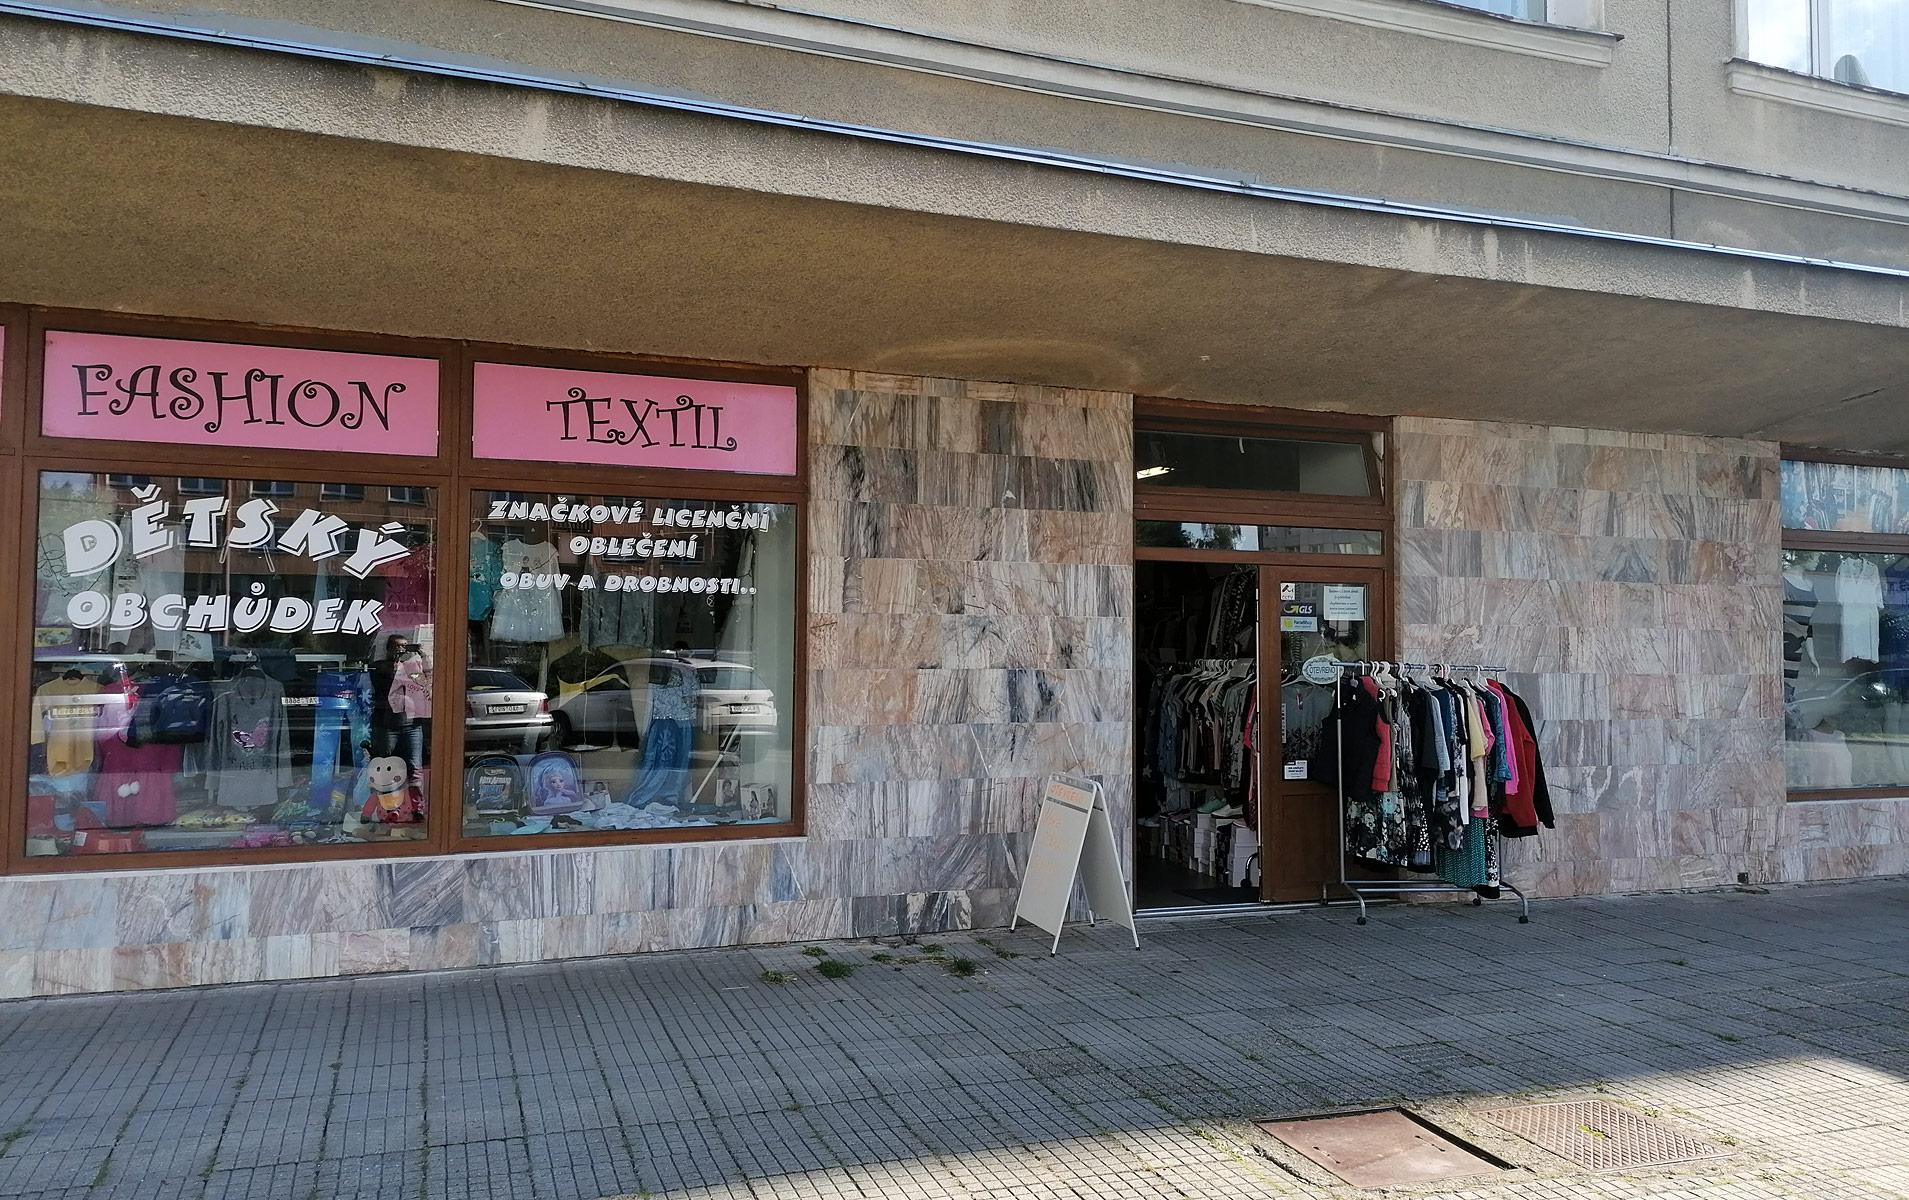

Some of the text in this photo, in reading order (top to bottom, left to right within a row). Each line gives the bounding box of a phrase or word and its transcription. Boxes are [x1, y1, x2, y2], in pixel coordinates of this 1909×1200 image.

[72, 364, 406, 433] FASHION
[546, 387, 737, 451] TEXTIL
[63, 484, 411, 580] DĚTSKÝ
[488, 496, 772, 532] ZNAČKOVÉ LICENČNÍ
[569, 532, 698, 559] OBLEČENÍ
[500, 573, 570, 590] OBUV
[578, 575, 596, 590] A
[67, 581, 384, 635] OBCHŮDEK
[1299, 605, 1313, 614] GLS
